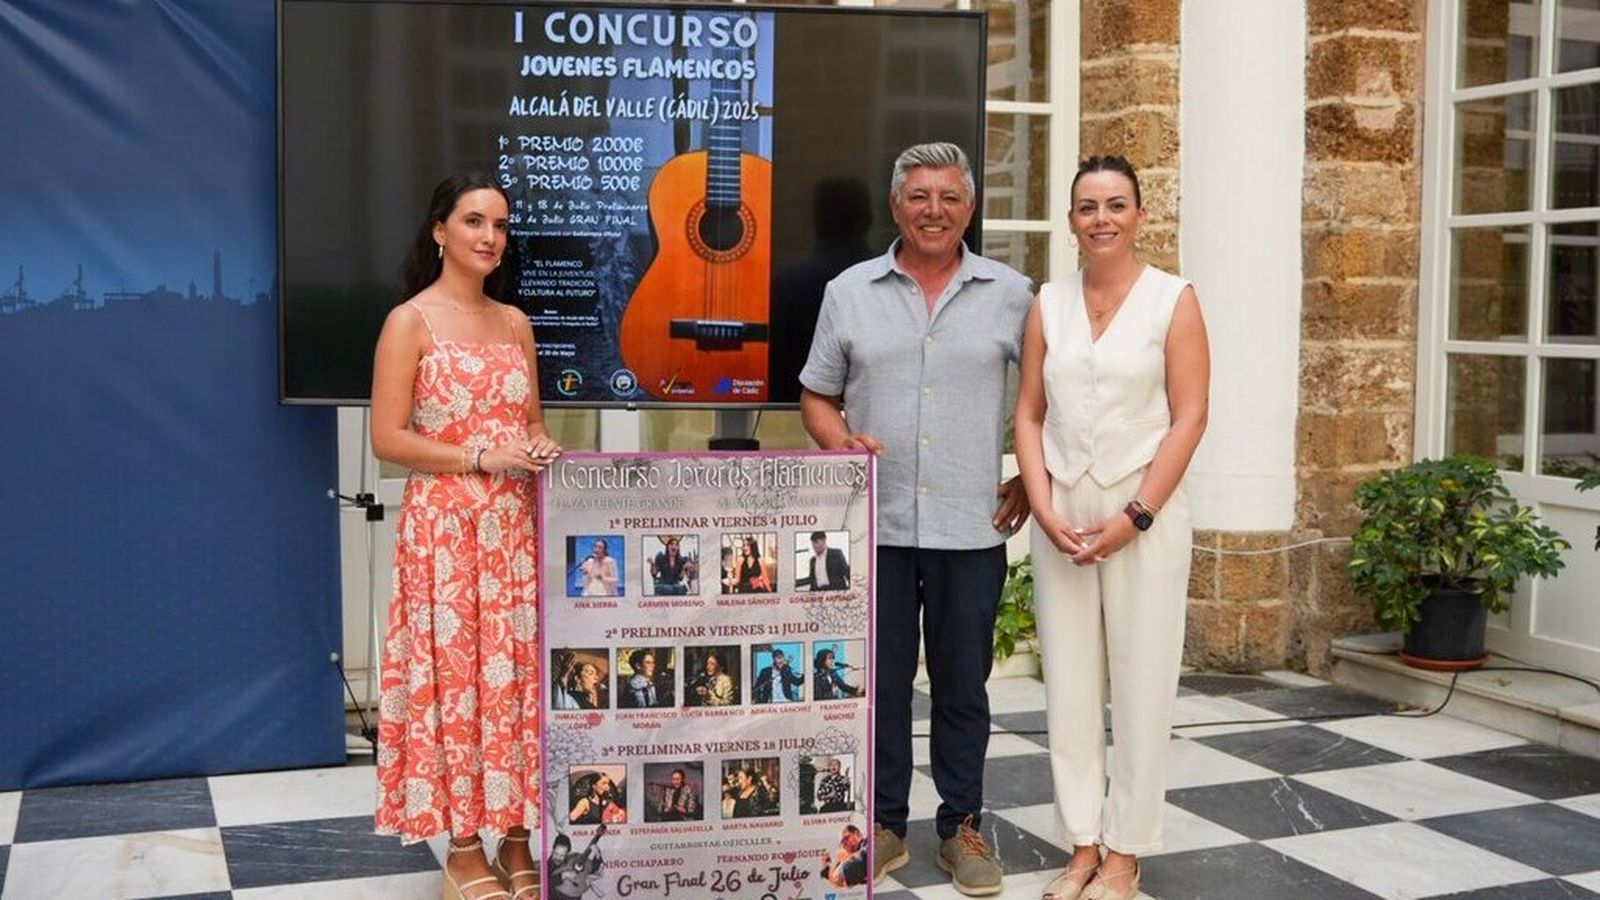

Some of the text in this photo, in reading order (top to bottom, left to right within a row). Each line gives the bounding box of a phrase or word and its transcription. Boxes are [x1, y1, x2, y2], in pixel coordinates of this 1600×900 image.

[514, 11, 759, 48] I CONCURSO
[521, 55, 756, 80] JOVENES FLAMENCOS
[509, 91, 759, 125] ALCALÁ DEL VALLE (CÁDIZ) 2025
[517, 136, 584, 151] PREMIO
[523, 155, 590, 172] PREMIO
[526, 174, 593, 191] PREMIO
[601, 175, 640, 191] 500€
[570, 215, 599, 225] GRAN
[605, 215, 638, 226] FINAL
[545, 260, 583, 269] FLAMENCO
[521, 279, 557, 287] LLEVANDO
[523, 288, 556, 297] CULTURA
[561, 459, 661, 489] Concurso
[624, 516, 709, 529] PRELIMINAR
[711, 516, 768, 528] VIERNES
[780, 515, 818, 528] JULIO
[638, 599, 705, 609] CARMEN MORENO
[621, 626, 706, 639] PRELIMINAR
[709, 624, 765, 637] VIERNES
[768, 624, 779, 635] 11
[782, 622, 819, 637] JULIO
[636, 711, 677, 720] FRANCISCO
[617, 743, 703, 756] PRELIMINAR
[705, 740, 761, 753] VIERNES
[764, 741, 776, 750] 18
[778, 738, 816, 751] JULIO
[749, 820, 784, 829] NAVARRO
[601, 859, 630, 869] NIÑO
[630, 857, 684, 868] CHAPARRO
[717, 853, 769, 863] FERNANDO
[617, 865, 810, 897] Gran Final 26 de Julio
